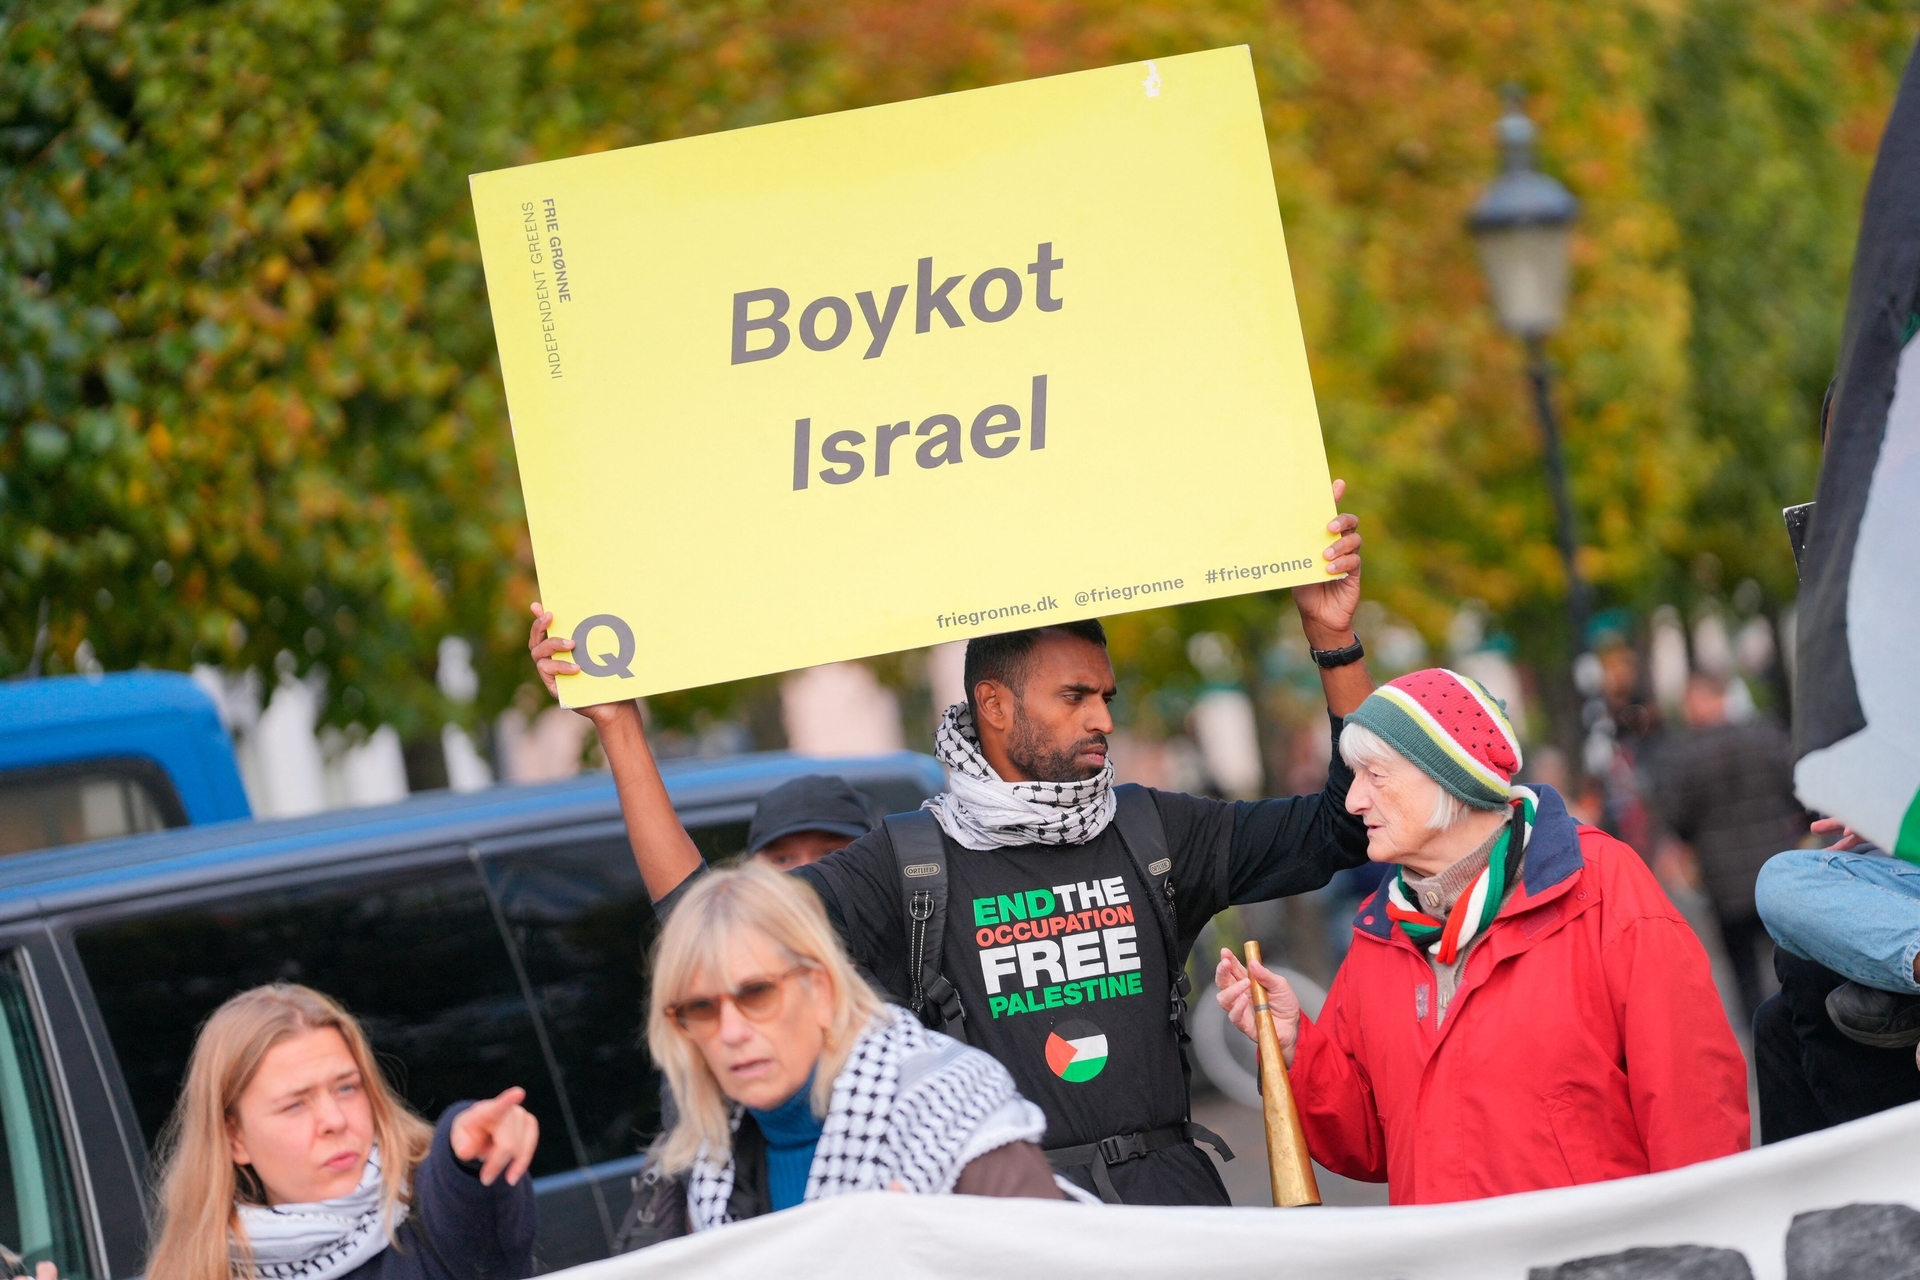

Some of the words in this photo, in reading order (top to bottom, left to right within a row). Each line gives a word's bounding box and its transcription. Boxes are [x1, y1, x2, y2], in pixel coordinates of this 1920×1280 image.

[521, 201, 544, 265] GREENS
[542, 197, 560, 233] FRIE
[549, 236, 572, 304] GRØNNE
[730, 241, 1065, 366] Boykot
[532, 269, 564, 380] INDEPENDENT
[792, 373, 1049, 492] Israel
[935, 595, 1059, 629] friegronne.dk
[1073, 576, 1185, 607] @friegronne
[1204, 556, 1314, 584] #friegronne
[571, 613, 637, 679] Q
[975, 904, 1135, 947] OCCUPATION
[978, 925, 1142, 995] FREE
[988, 972, 1144, 1019] PALESTINE
